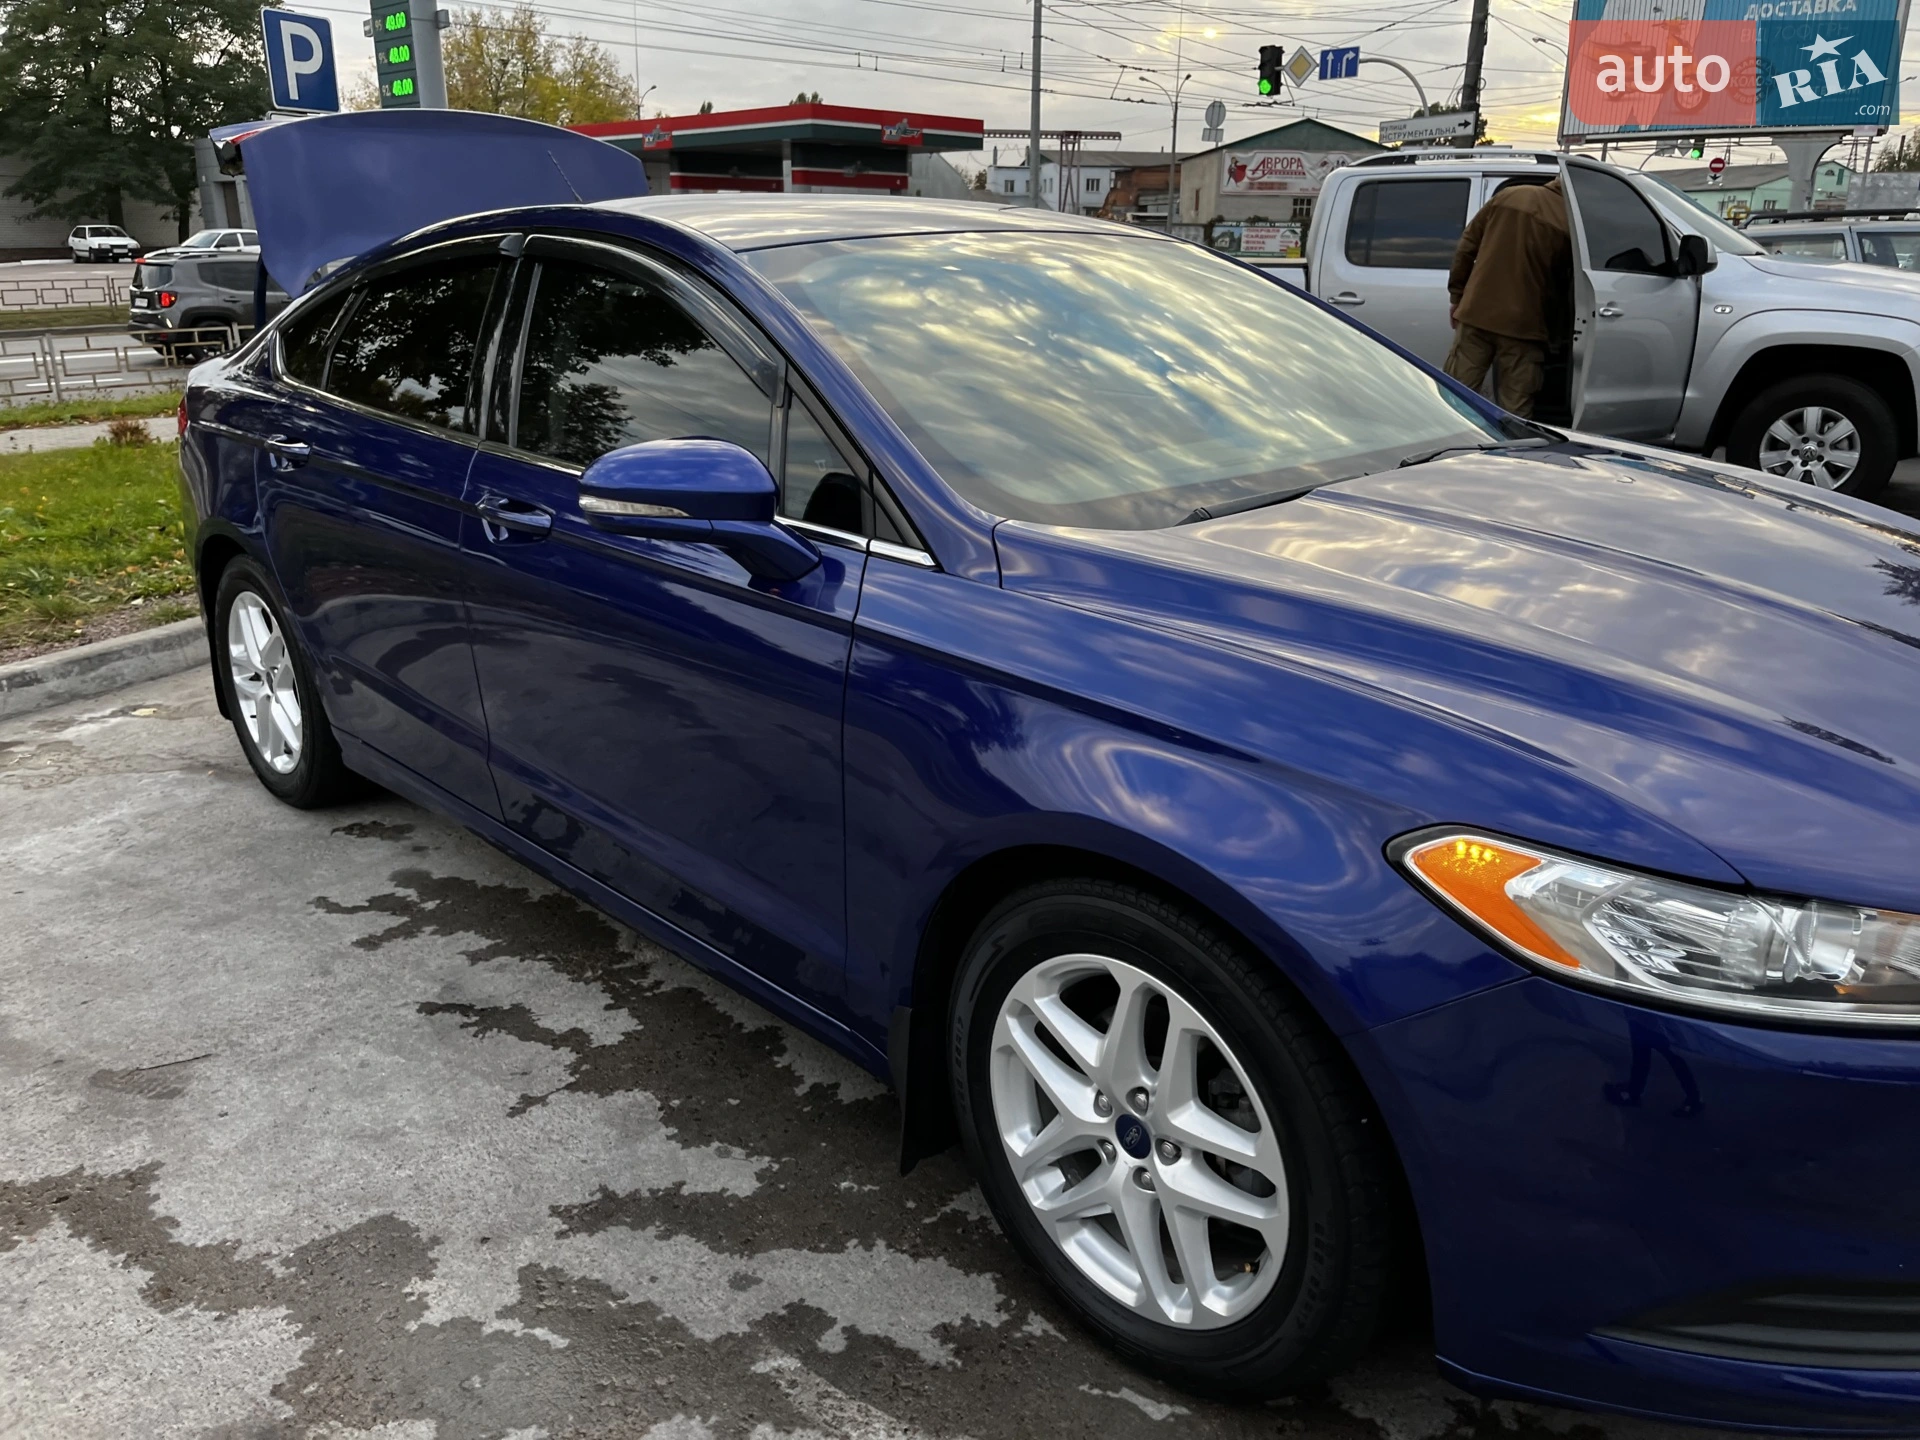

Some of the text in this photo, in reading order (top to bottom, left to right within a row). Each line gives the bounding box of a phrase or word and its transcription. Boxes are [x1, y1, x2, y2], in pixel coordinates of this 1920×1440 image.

[1743, 0, 1857, 21] ДОСТАВКА
[280, 19, 323, 100] P
[1252, 156, 1304, 176] АВРОРА
